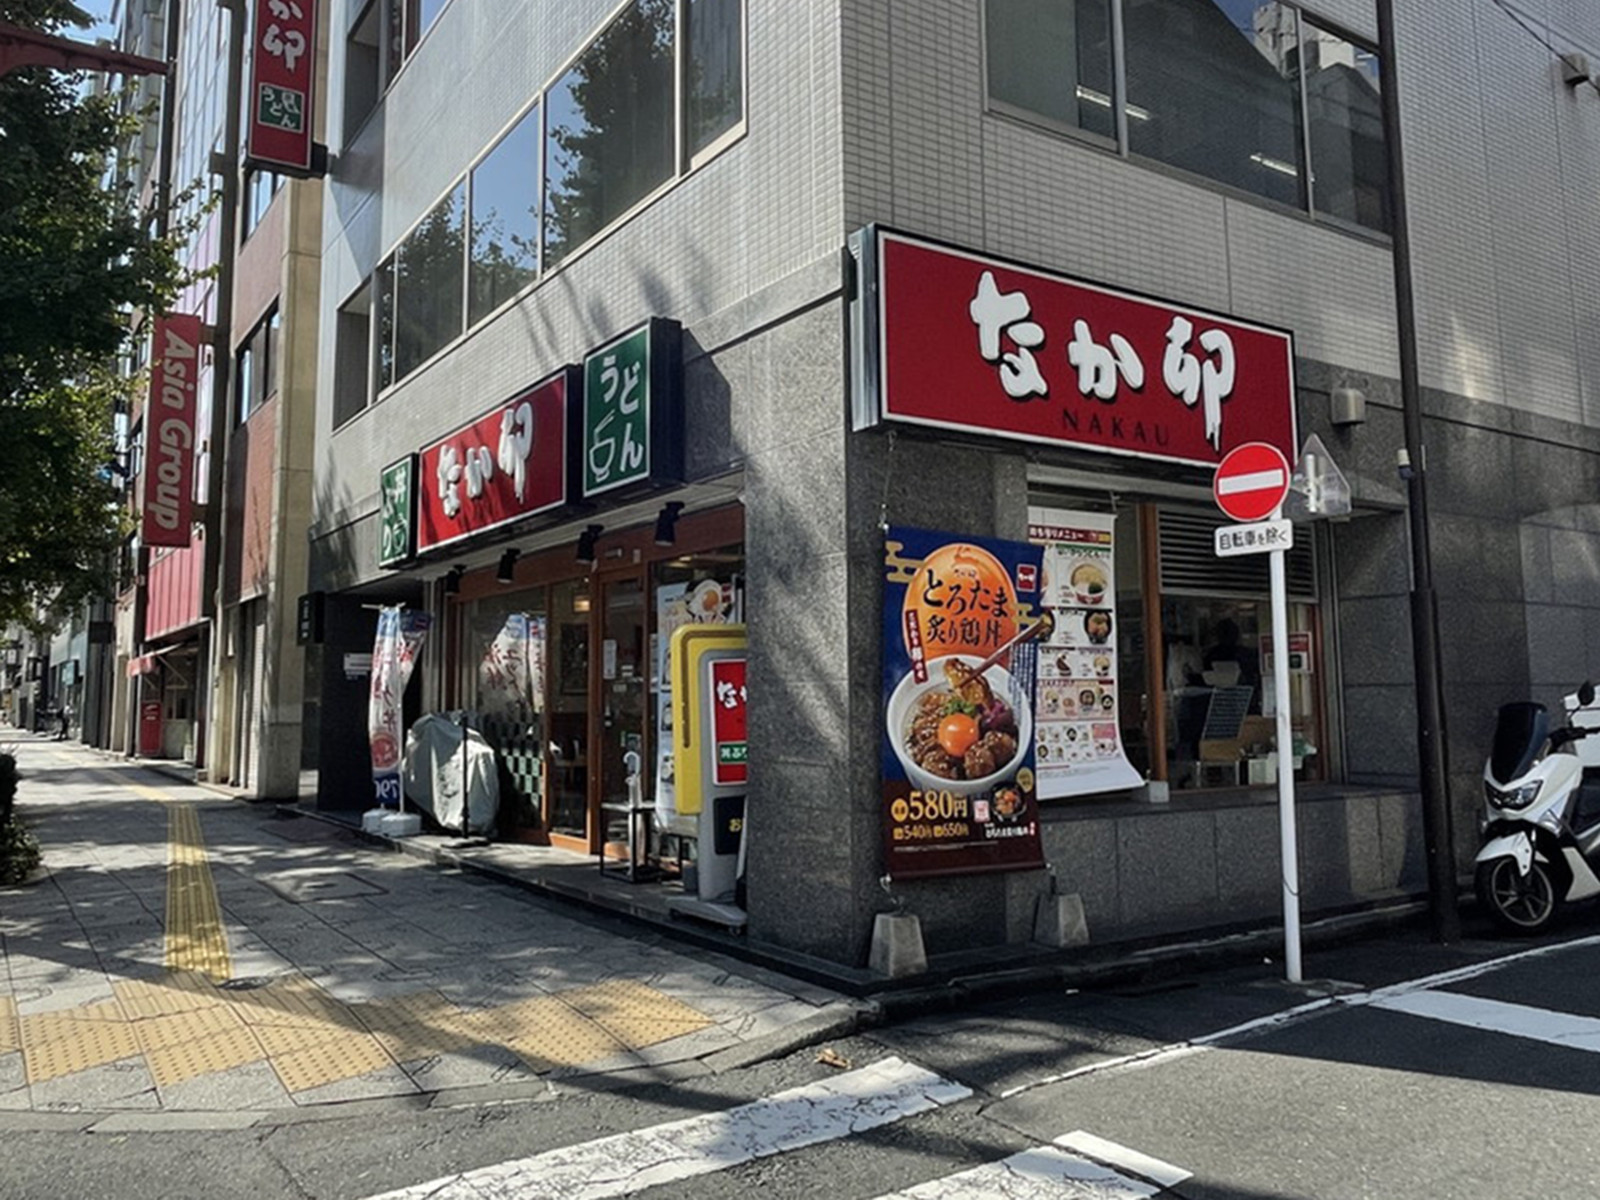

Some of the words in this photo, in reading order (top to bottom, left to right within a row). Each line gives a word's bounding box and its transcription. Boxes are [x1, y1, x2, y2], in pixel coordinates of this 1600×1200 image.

[163, 329, 195, 411] Asia
[969, 270, 1236, 452] なか卯
[600, 355, 644, 473] うどん
[1062, 408, 1170, 446] NAKAU
[147, 417, 192, 531] Group
[437, 401, 534, 517] なか卯
[1219, 526, 1288, 551] 自転車を除く
[923, 568, 1009, 618] とろたま
[926, 613, 1002, 648] 炙り鶏丼
[909, 789, 968, 820] 580円
